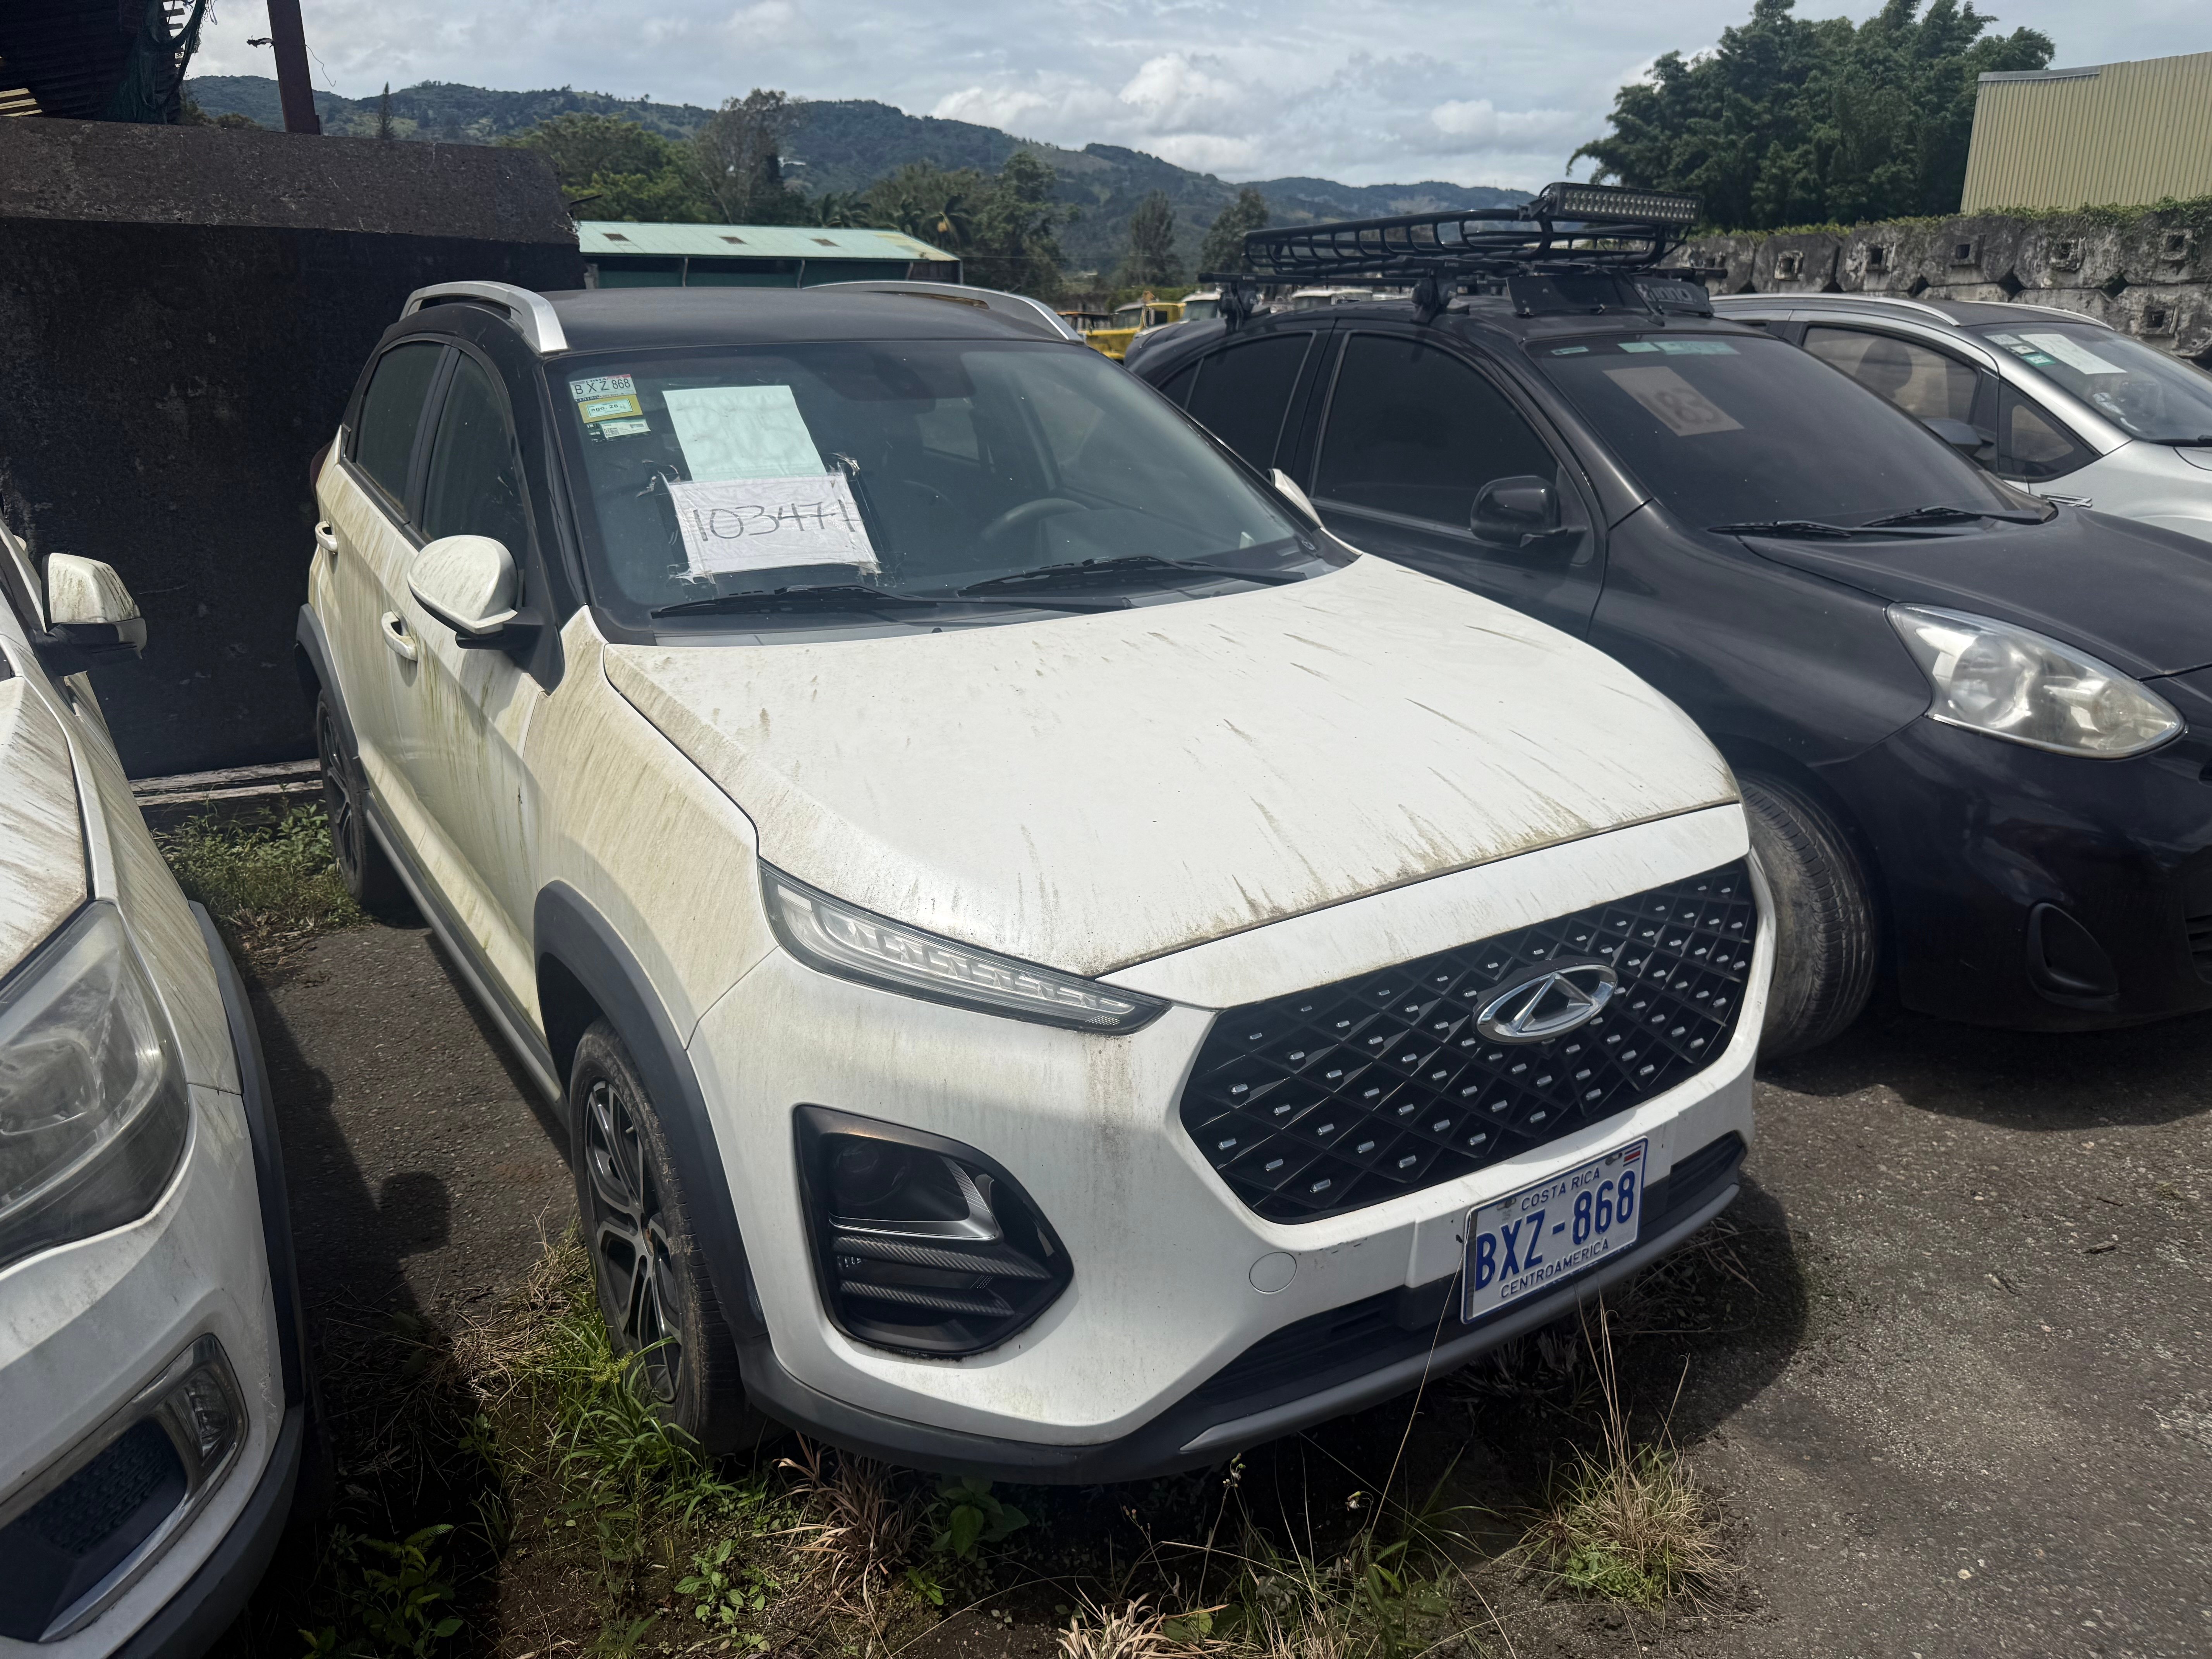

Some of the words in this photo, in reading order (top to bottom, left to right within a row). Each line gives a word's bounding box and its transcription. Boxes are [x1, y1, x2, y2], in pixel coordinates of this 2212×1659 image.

[611, 378, 630, 389] 868
[1521, 1182, 1566, 1211] COSTA
[1571, 1167, 1600, 1190] RICA
[1475, 1170, 1635, 1291] BXZ-868
[1501, 1238, 1609, 1298] CENTROAMERICA
